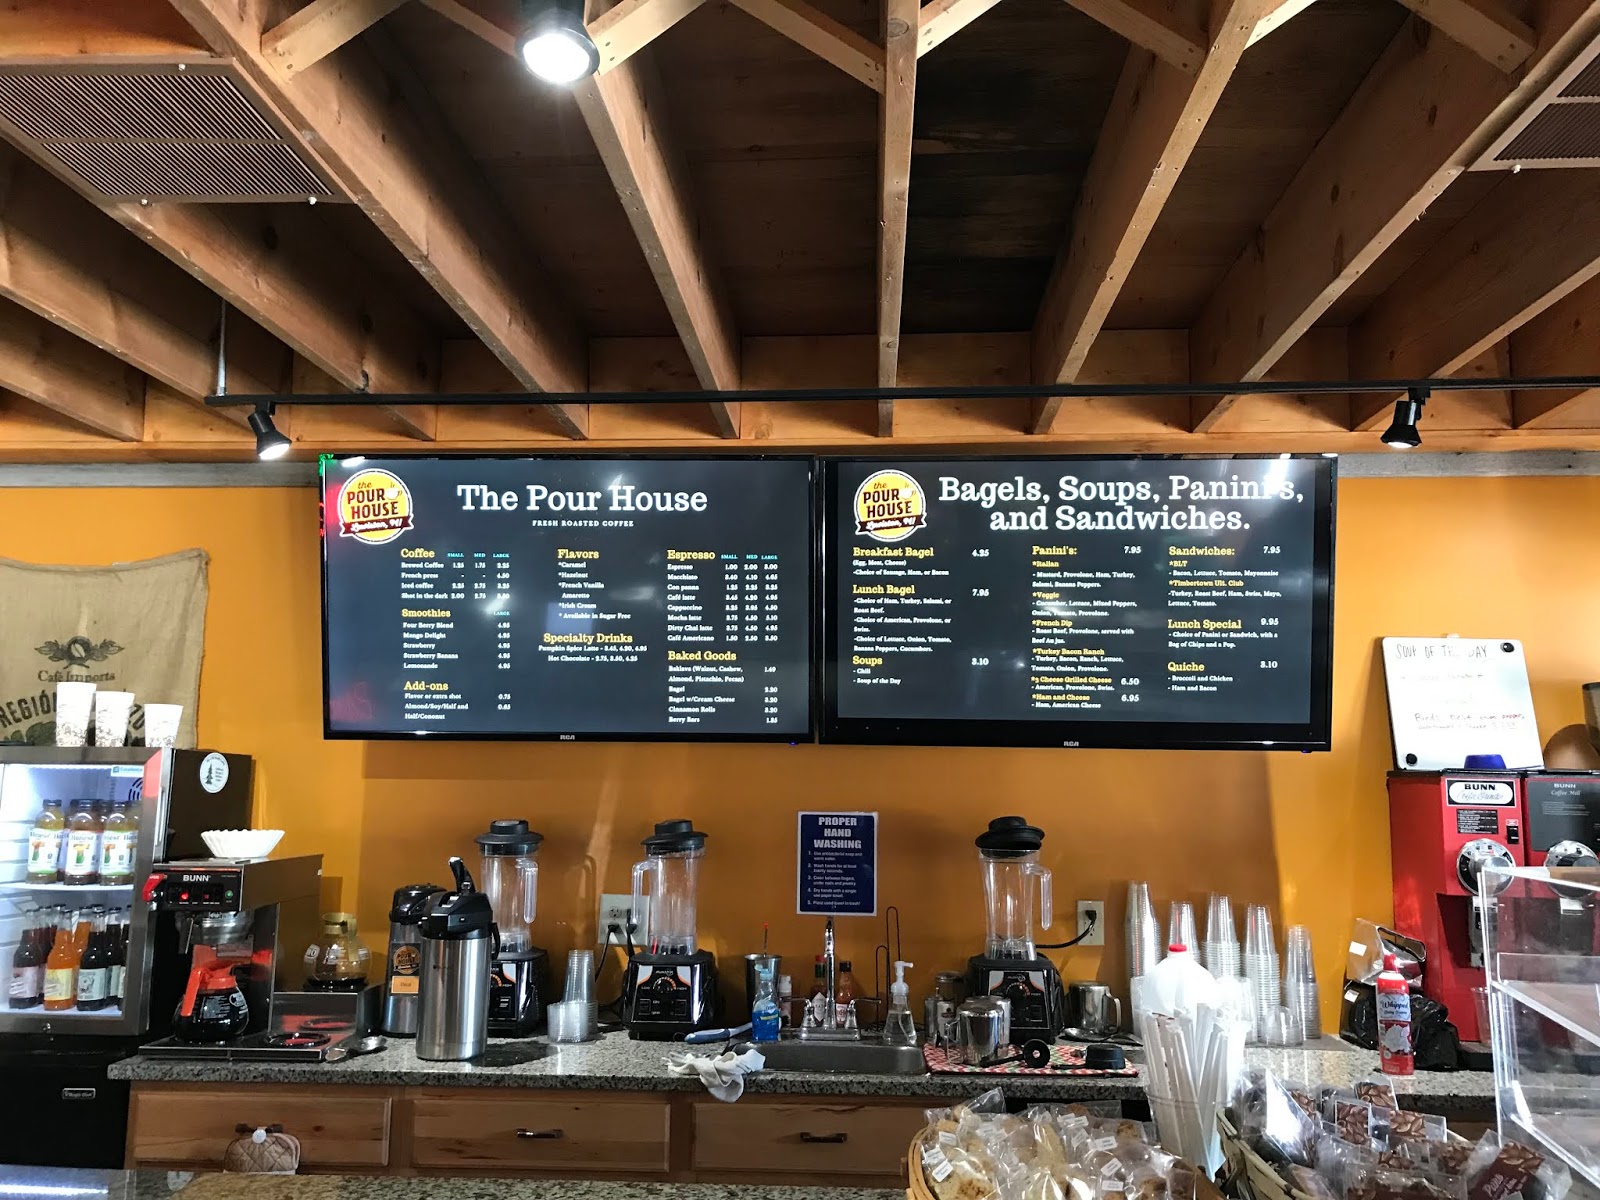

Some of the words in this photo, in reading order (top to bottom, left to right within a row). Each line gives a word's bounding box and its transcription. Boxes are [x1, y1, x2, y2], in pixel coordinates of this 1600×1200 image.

[358, 481, 372, 489] the
[347, 488, 385, 504] POUR
[863, 488, 900, 504] POUR
[938, 476, 1050, 508] Bagels,
[1058, 476, 1160, 506] Soups,
[1168, 474, 1303, 503] Paninis,
[456, 484, 518, 511] The
[526, 484, 602, 511] Pour
[608, 485, 708, 512] House
[351, 502, 398, 519] HOUSE
[866, 500, 912, 518] HOUSE
[990, 506, 1048, 530] and
[1056, 505, 1250, 530] Sandwiches.
[401, 548, 434, 558] Coffee
[558, 549, 599, 558] Flavors
[853, 547, 903, 556] Breakfast
[905, 548, 934, 558] Bagel
[1032, 546, 1077, 554] Panini's:
[1169, 546, 1234, 555] Sandwiches:
[667, 550, 715, 561] Espresso
[853, 585, 884, 593] Lunch
[886, 585, 915, 596] Bagel
[402, 609, 450, 617] Smoothies
[1168, 620, 1200, 628] Lunch
[1203, 620, 1241, 630] Special
[544, 632, 594, 644] Specialty
[597, 634, 632, 642] Drinks
[668, 651, 701, 660] Baked
[704, 651, 736, 660] Goods
[1396, 644, 1416, 659] SOUP
[1424, 646, 1435, 658] OF
[853, 656, 882, 666] Soups
[1168, 662, 1204, 671] Quiche
[38, 670, 62, 682] Café
[66, 671, 115, 682] Imports
[404, 681, 448, 690] Add-ons
[818, 817, 857, 826] PROPER
[824, 828, 851, 837] HAND
[814, 839, 862, 849] WASHING
